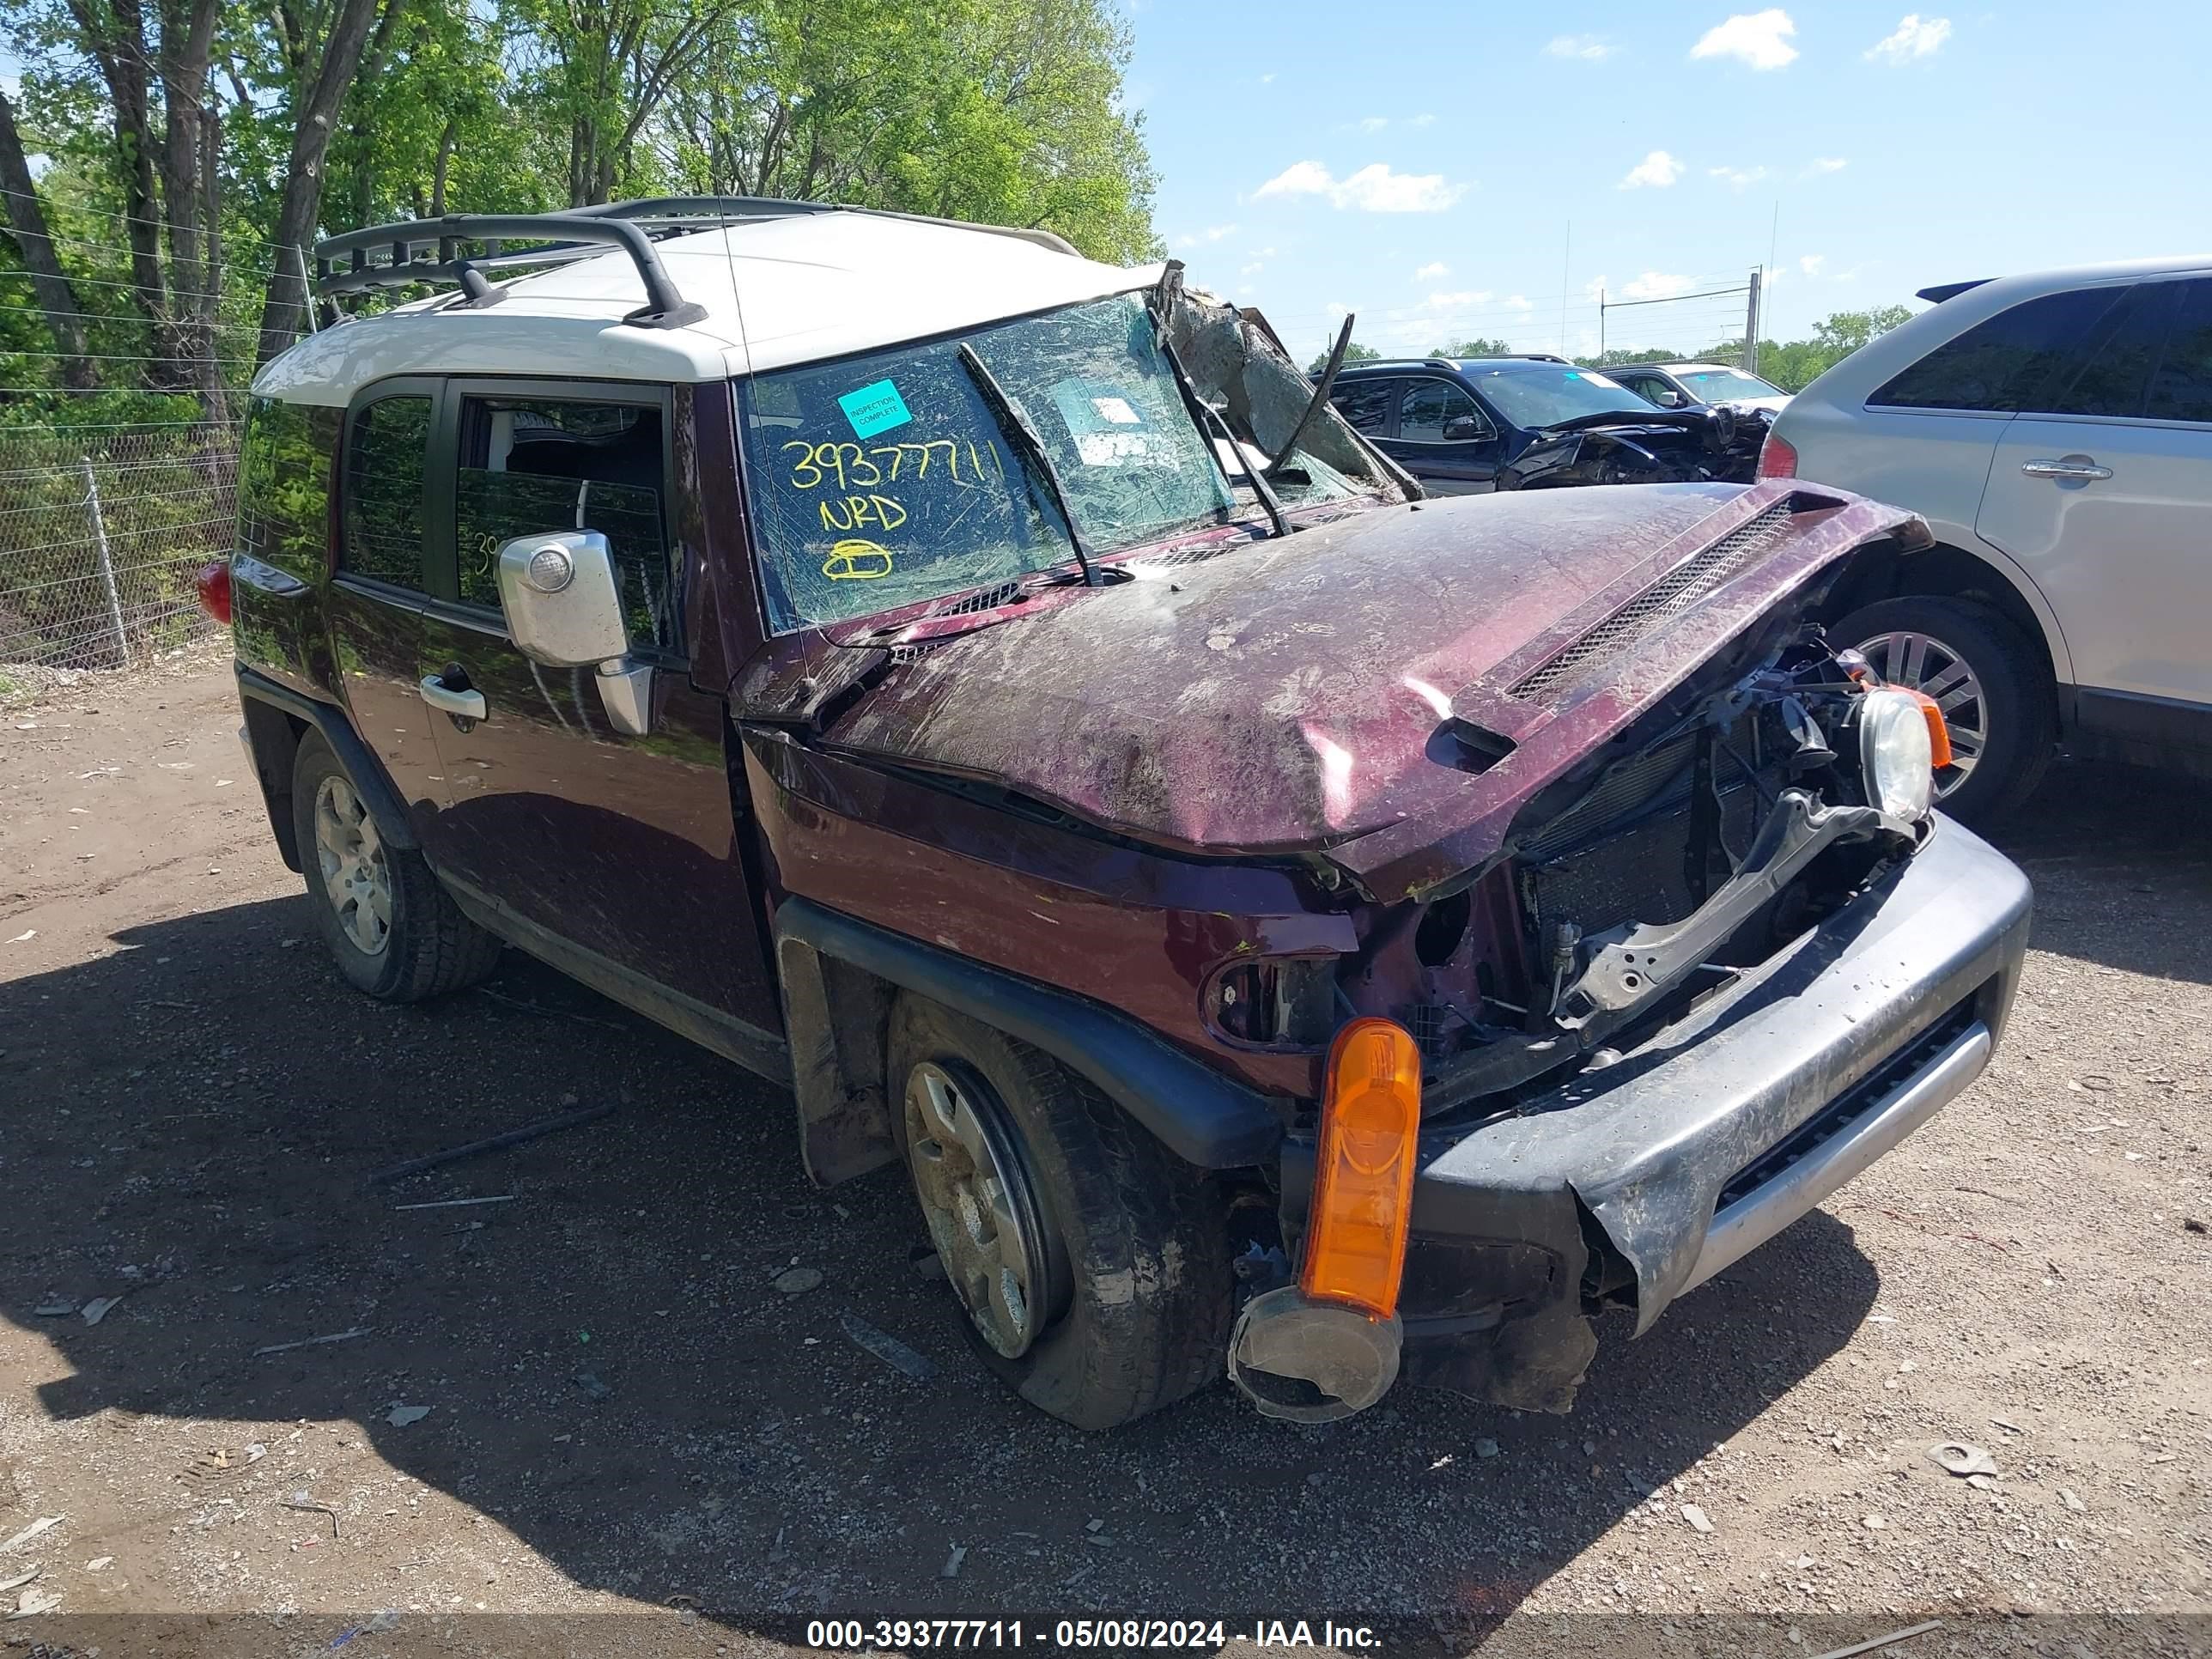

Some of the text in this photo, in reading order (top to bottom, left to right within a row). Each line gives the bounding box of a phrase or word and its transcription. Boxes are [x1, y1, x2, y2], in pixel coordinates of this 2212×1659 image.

[850, 395, 896, 418] INSPECTION
[859, 404, 899, 426] COMPLETE
[781, 440, 1006, 490] 39377711
[819, 494, 907, 531] NRD
